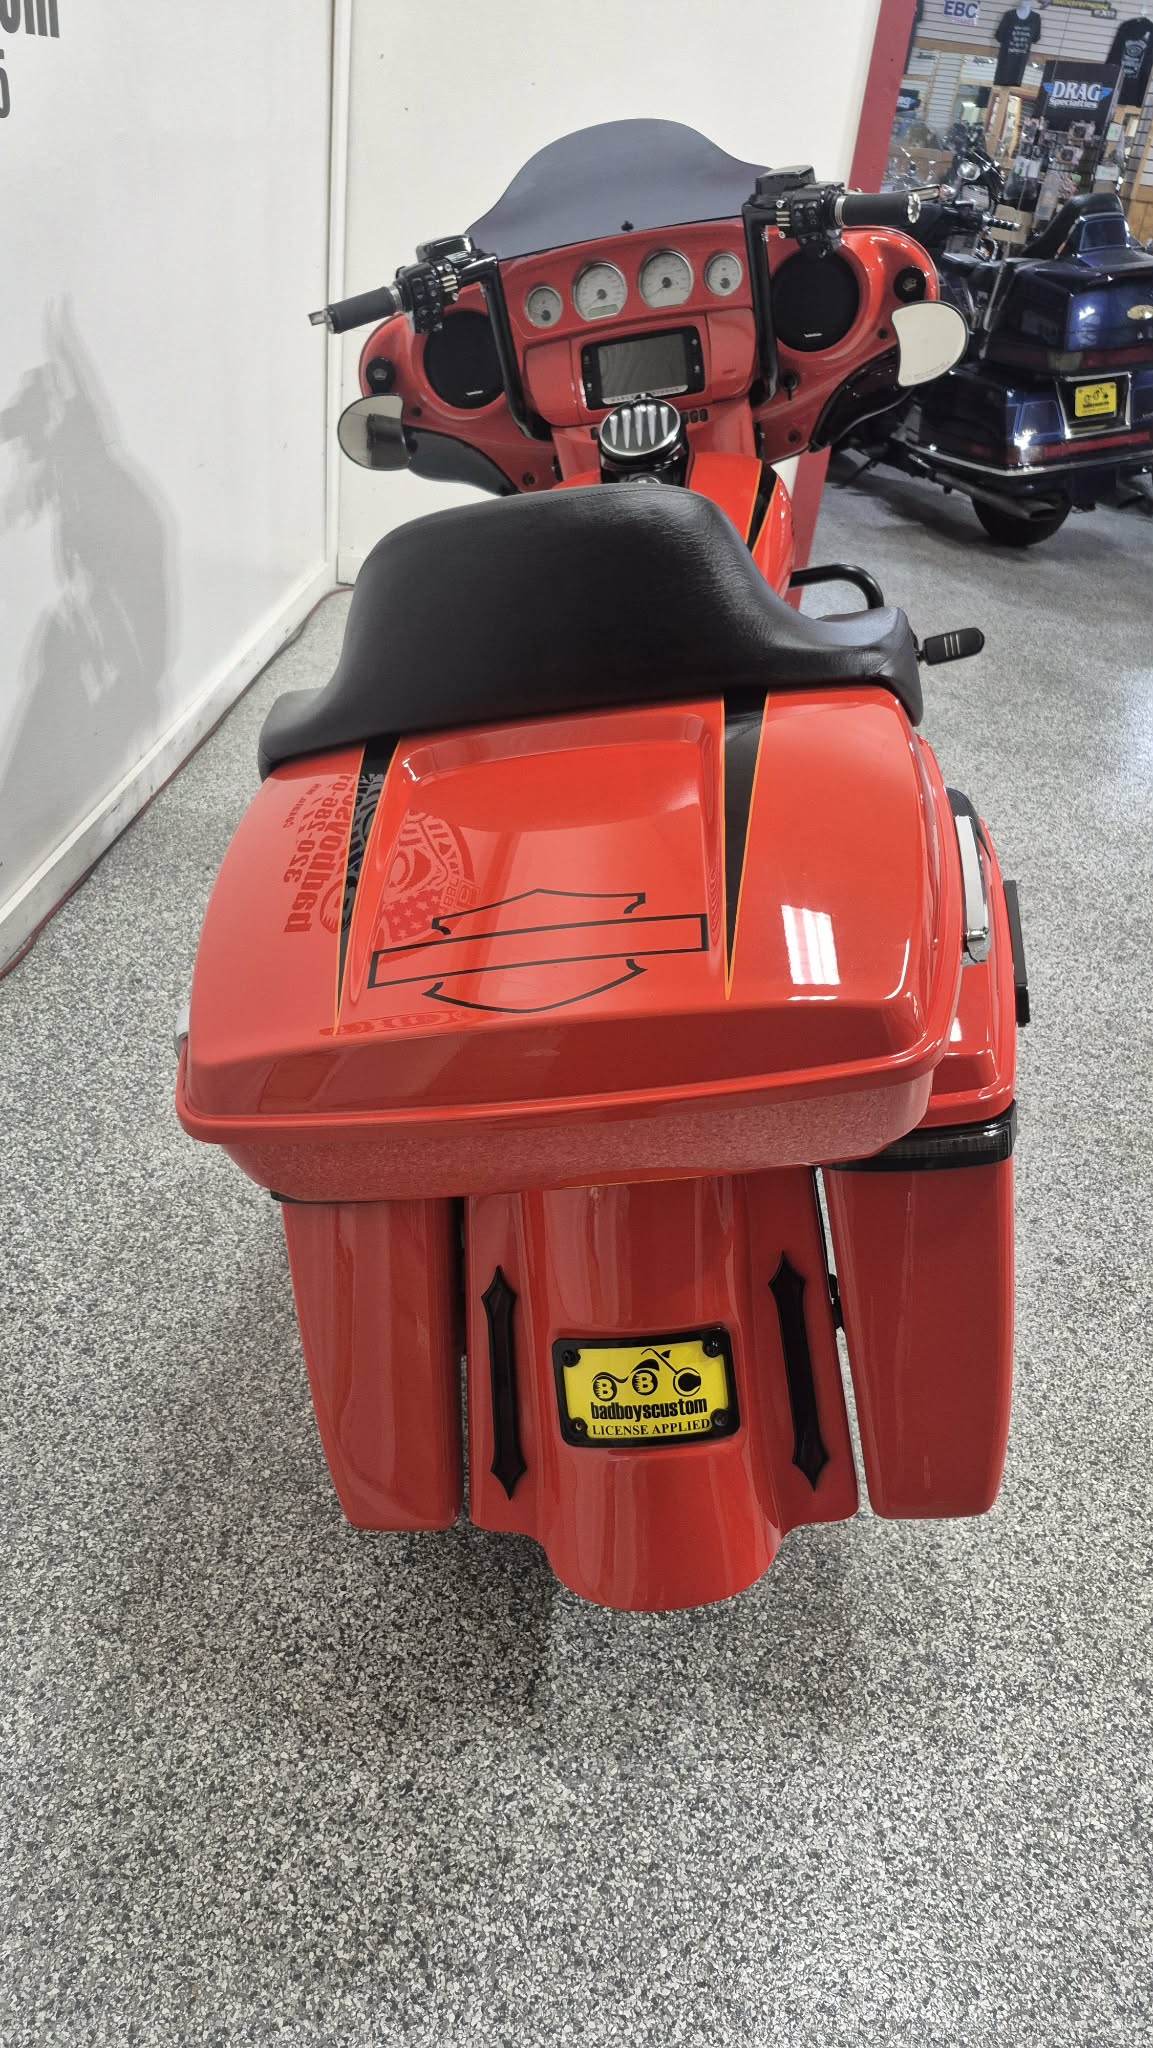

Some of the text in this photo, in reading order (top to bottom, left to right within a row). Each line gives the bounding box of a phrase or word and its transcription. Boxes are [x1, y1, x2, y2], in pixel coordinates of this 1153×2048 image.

[944, 1, 978, 18] EBC
[1052, 80, 1102, 101] DRAG
[1049, 97, 1099, 108] Specialties
[590, 1398, 708, 1422] badboyscustom
[592, 1419, 711, 1436] LICENSE APPLIED
